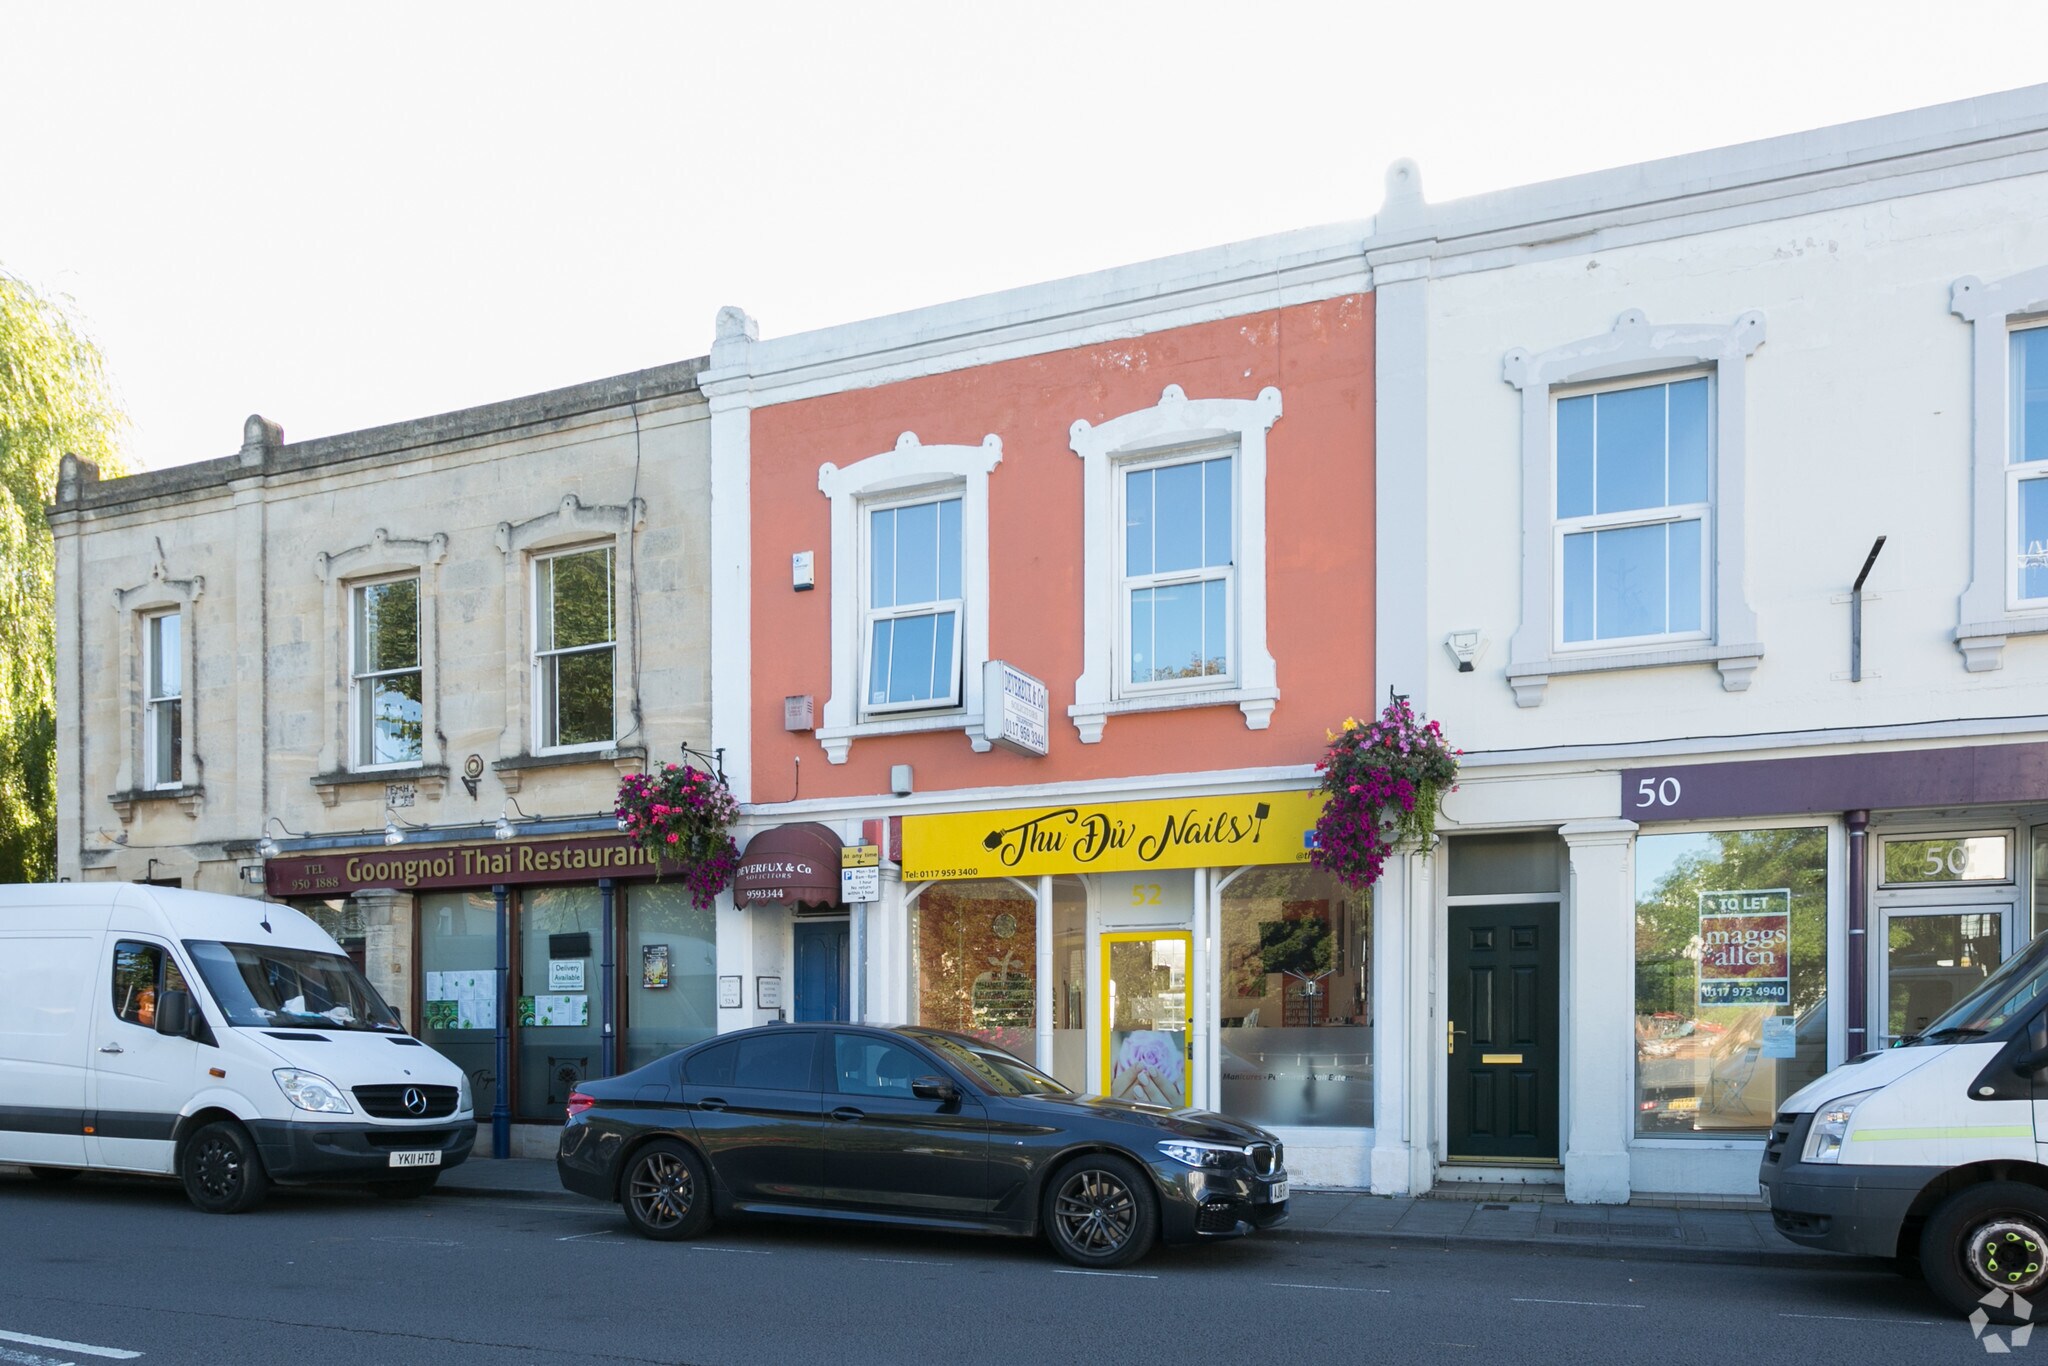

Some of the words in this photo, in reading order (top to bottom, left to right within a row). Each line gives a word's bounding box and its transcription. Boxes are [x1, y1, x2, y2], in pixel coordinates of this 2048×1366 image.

[1004, 670, 1032, 704] DEVEREUX
[1005, 718, 1019, 737] 0117
[1031, 729, 1044, 748] 3344
[1635, 776, 1681, 807] 50
[1000, 808, 1078, 867] Thu
[1138, 809, 1253, 862] Nails
[304, 864, 325, 875] TEL
[345, 850, 455, 887] Goongnoi
[461, 846, 512, 876] Thai
[785, 862, 795, 872] &
[1923, 846, 1969, 876] 50
[905, 870, 919, 879] Tel:
[919, 870, 940, 878] 0117
[941, 869, 957, 877] 959
[957, 867, 978, 876] 3400
[292, 878, 310, 890] 950
[315, 877, 339, 889] 1888
[746, 889, 784, 899] 9593344
[1131, 884, 1163, 907] 52
[1718, 898, 1739, 910] TO
[1743, 896, 1769, 910] LET
[1706, 928, 1787, 949] maggs
[1715, 946, 1776, 966] allen
[555, 964, 580, 973] Delivery
[1704, 986, 1729, 997] 0117
[1732, 987, 1753, 997] 973
[1755, 986, 1785, 996] 4940
[1222, 1072, 1263, 1081] Manicures
